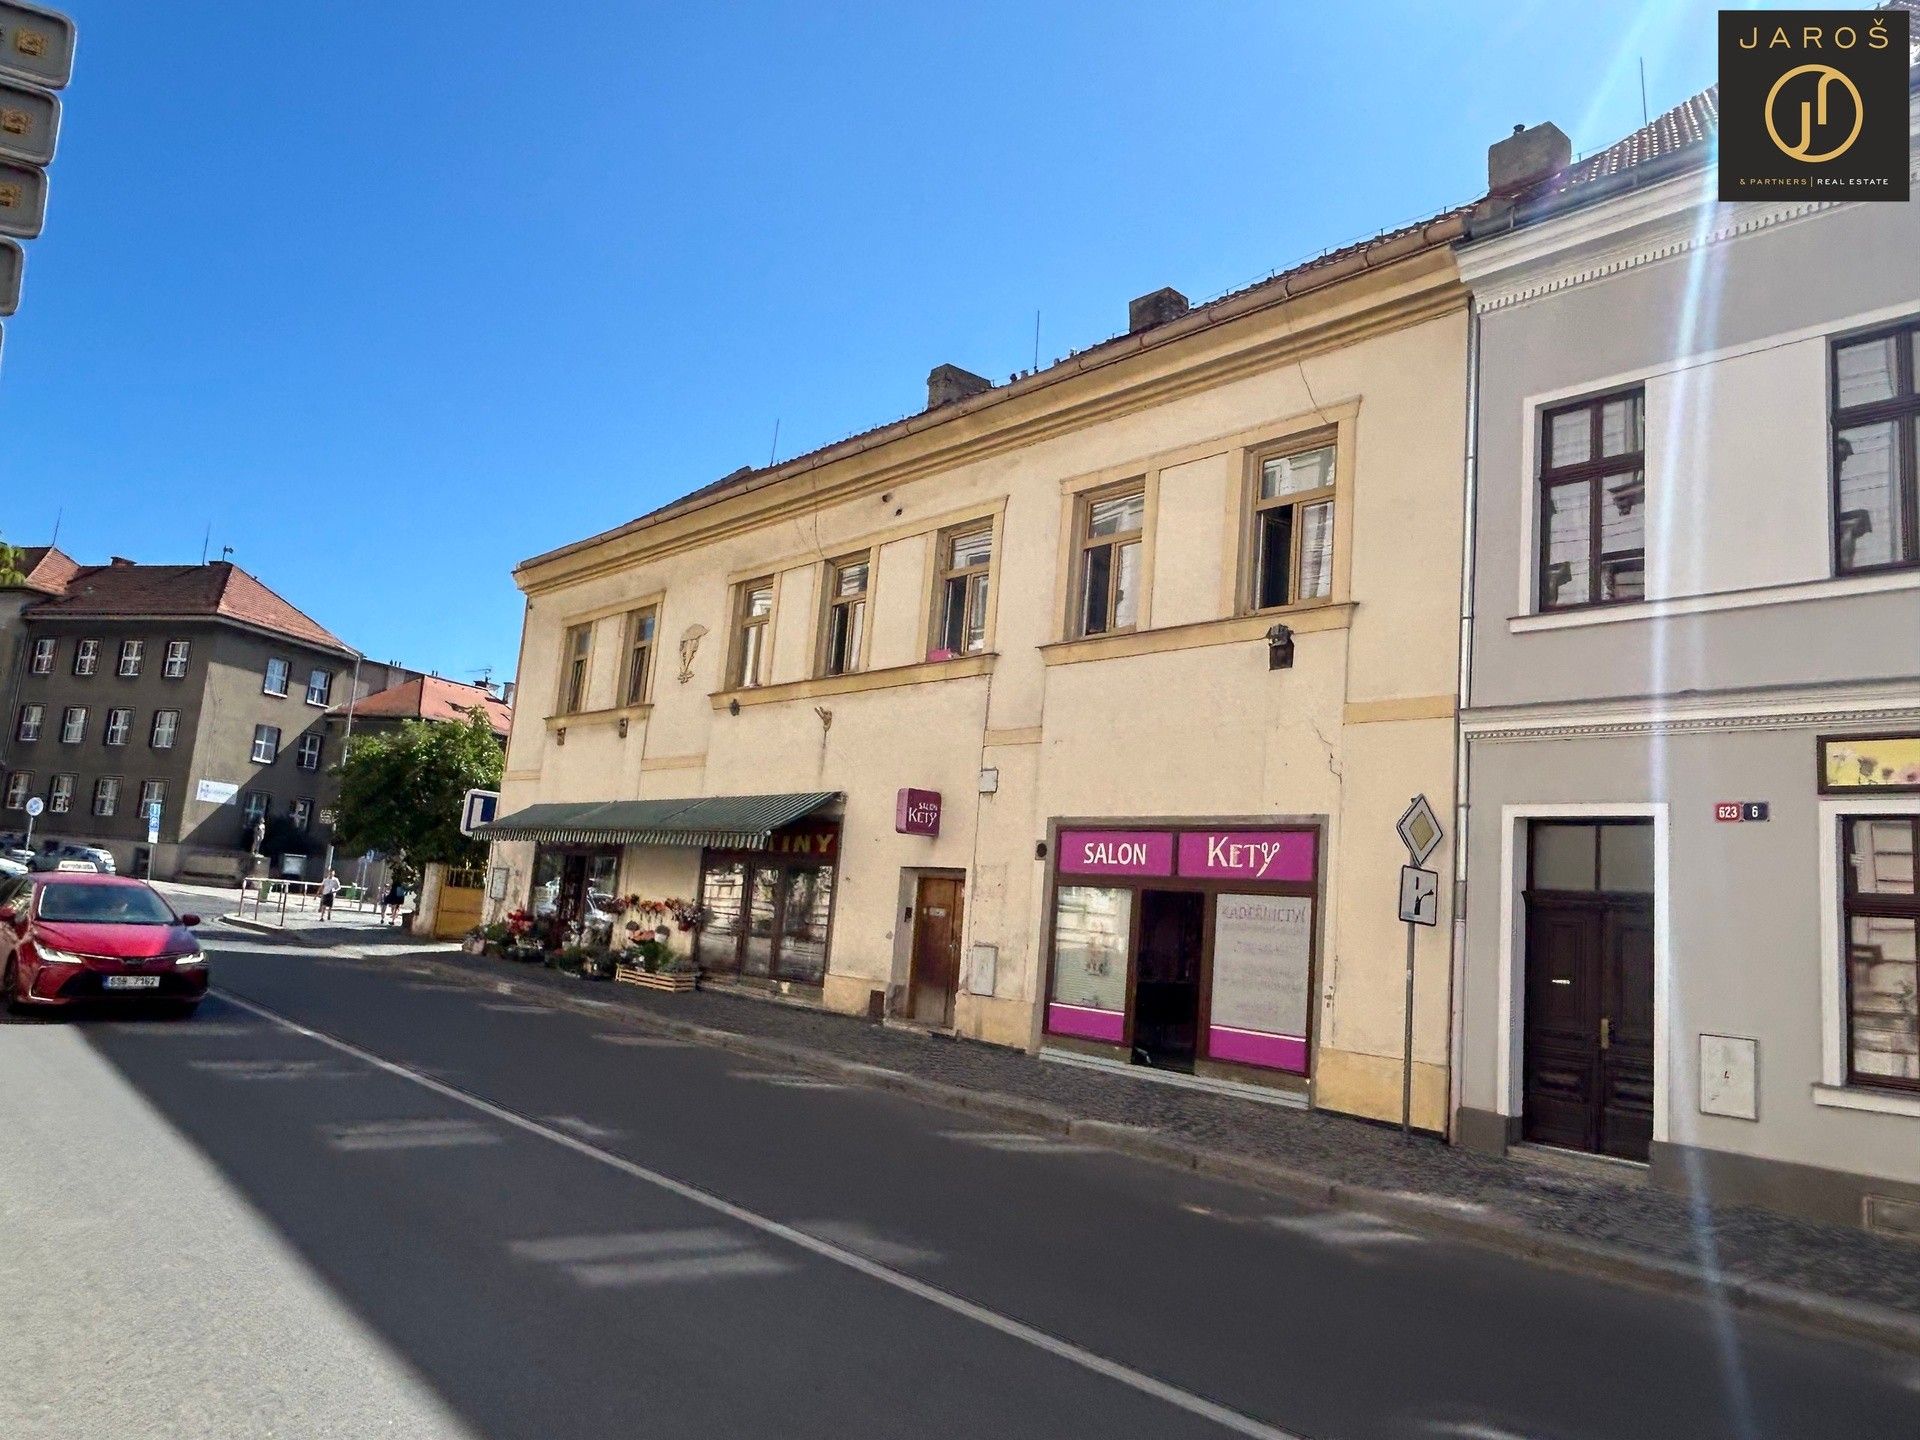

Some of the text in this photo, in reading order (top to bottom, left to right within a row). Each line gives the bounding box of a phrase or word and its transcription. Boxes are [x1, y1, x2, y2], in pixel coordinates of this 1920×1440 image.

[1719, 806, 1738, 818] 623
[1751, 805, 1759, 818] 6
[1084, 843, 1147, 865] SALON
